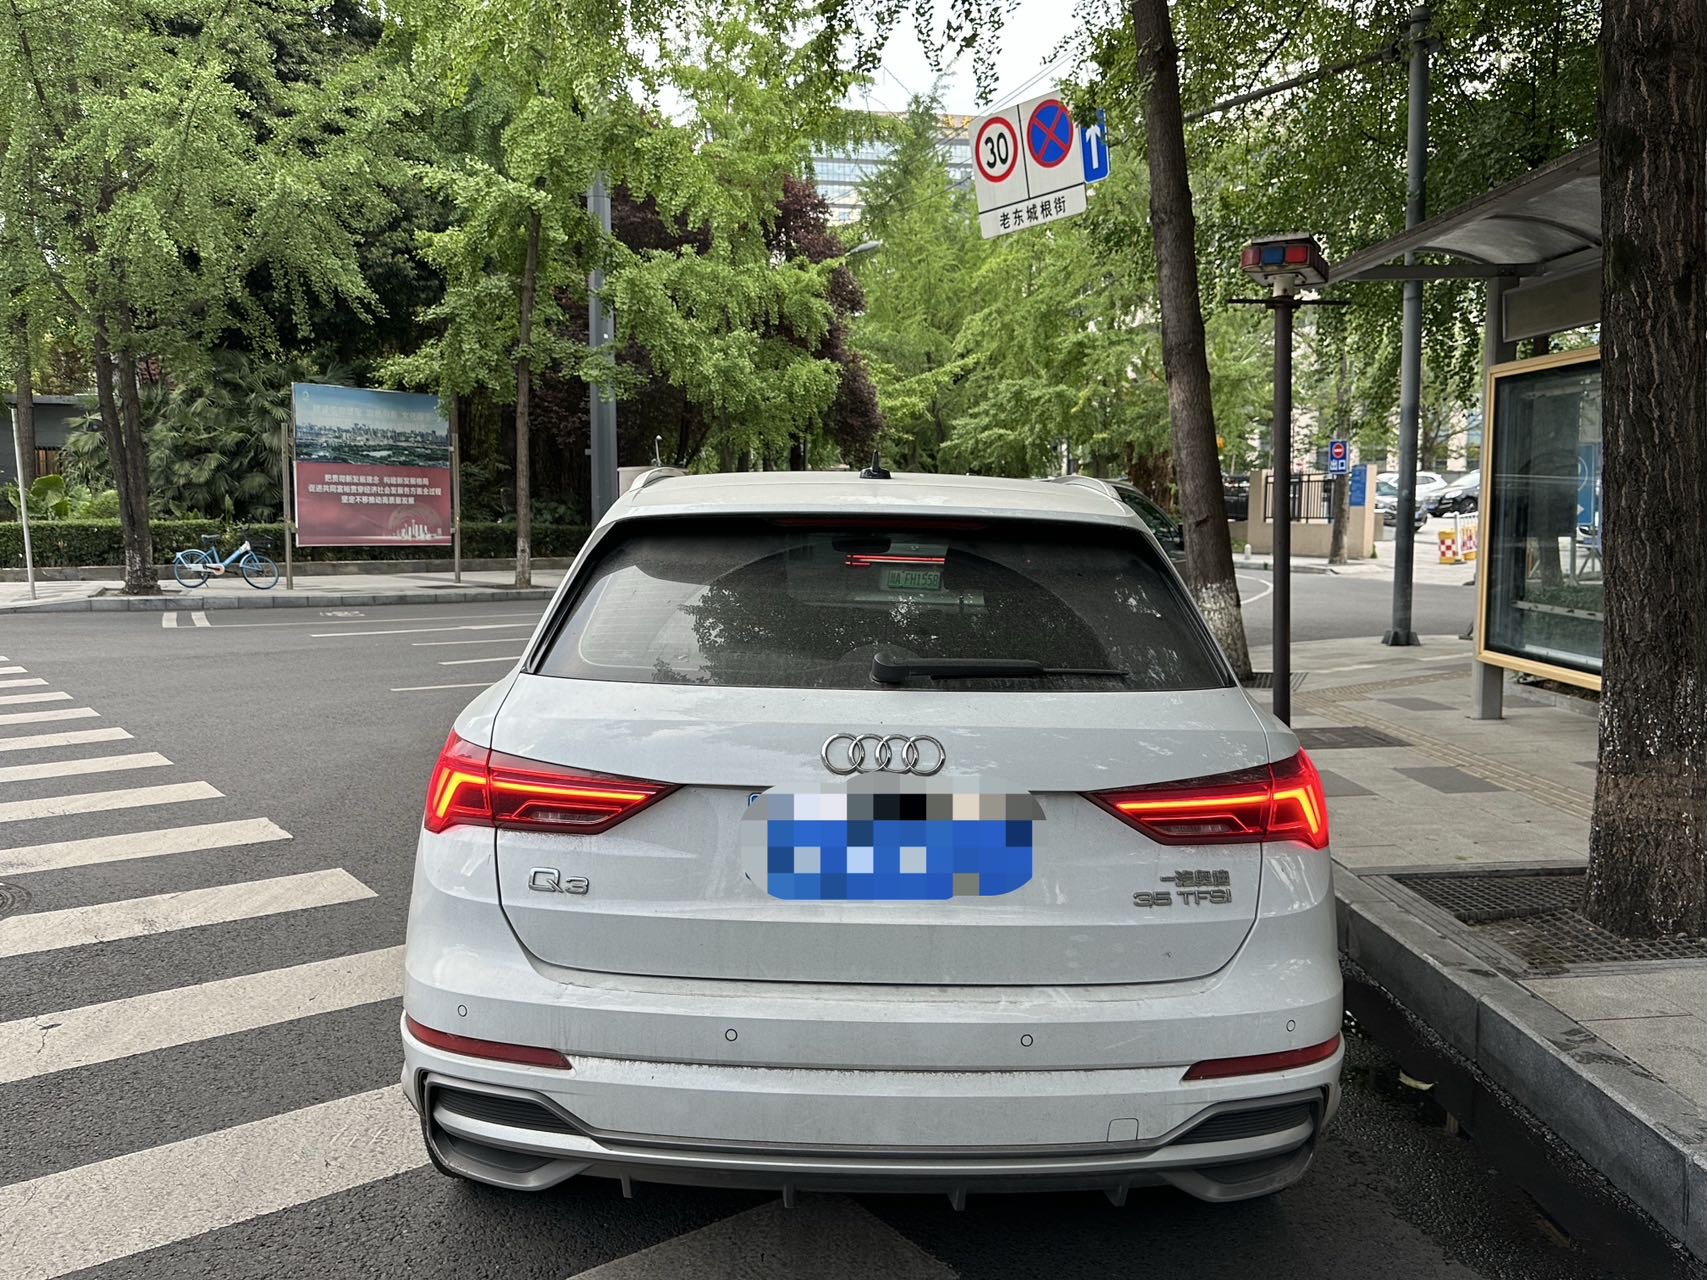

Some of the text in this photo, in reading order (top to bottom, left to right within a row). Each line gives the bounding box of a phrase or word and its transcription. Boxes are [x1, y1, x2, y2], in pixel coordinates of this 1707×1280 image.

[984, 132, 1009, 169] 30
[999, 195, 1067, 230] 老东城根街
[528, 867, 590, 895] Q3
[1160, 869, 1231, 888] 一汽奥迪
[1133, 888, 1232, 907] 35 TFSI
